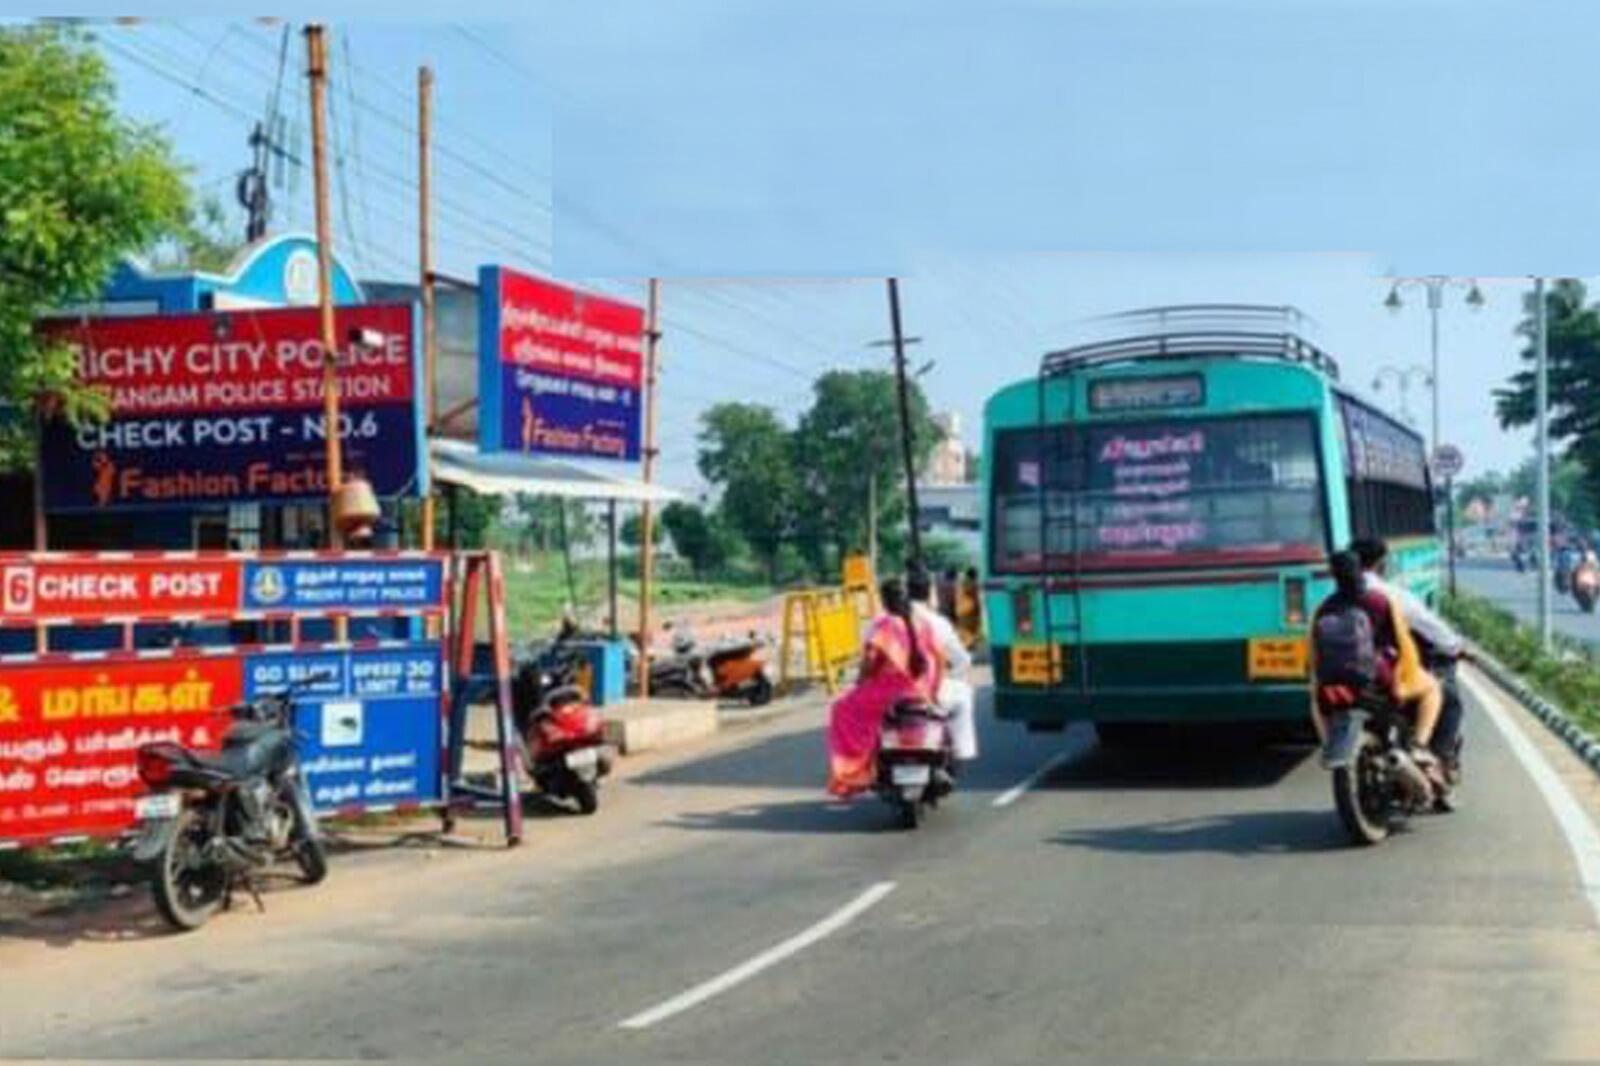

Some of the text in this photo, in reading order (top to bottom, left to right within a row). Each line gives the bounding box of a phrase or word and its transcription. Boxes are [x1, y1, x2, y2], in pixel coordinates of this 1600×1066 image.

[185, 341, 267, 375] CITY
[203, 379, 287, 406] POLICE
[76, 417, 187, 452] CHECK
[192, 416, 273, 446] POST
[119, 468, 240, 499] Fashion
[37, 574, 139, 601] CHECK
[150, 571, 222, 598] POST
[253, 665, 284, 684] GO
